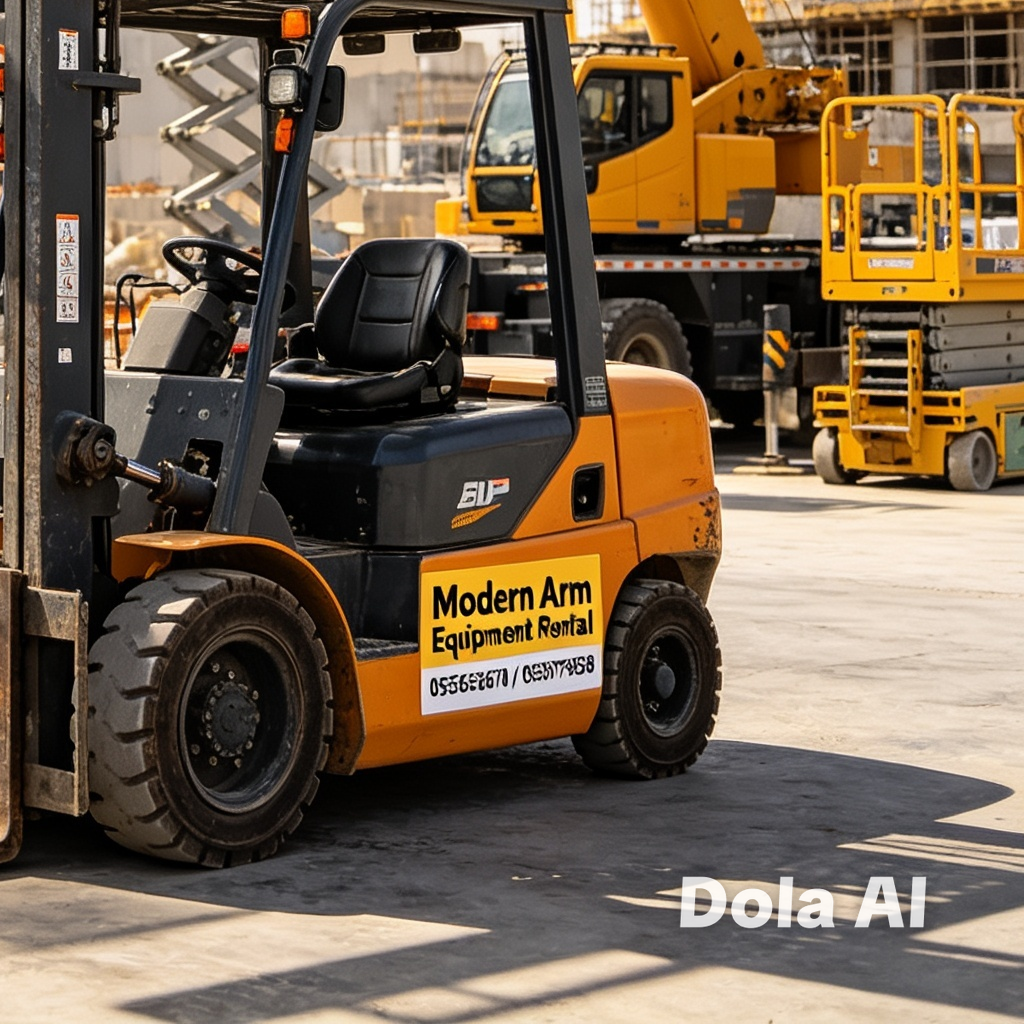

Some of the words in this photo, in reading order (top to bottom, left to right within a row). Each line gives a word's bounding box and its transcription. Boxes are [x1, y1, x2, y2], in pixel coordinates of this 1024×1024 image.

[432, 580, 534, 619] Modern
[539, 576, 592, 608] Arm
[432, 619, 533, 660] Equipment
